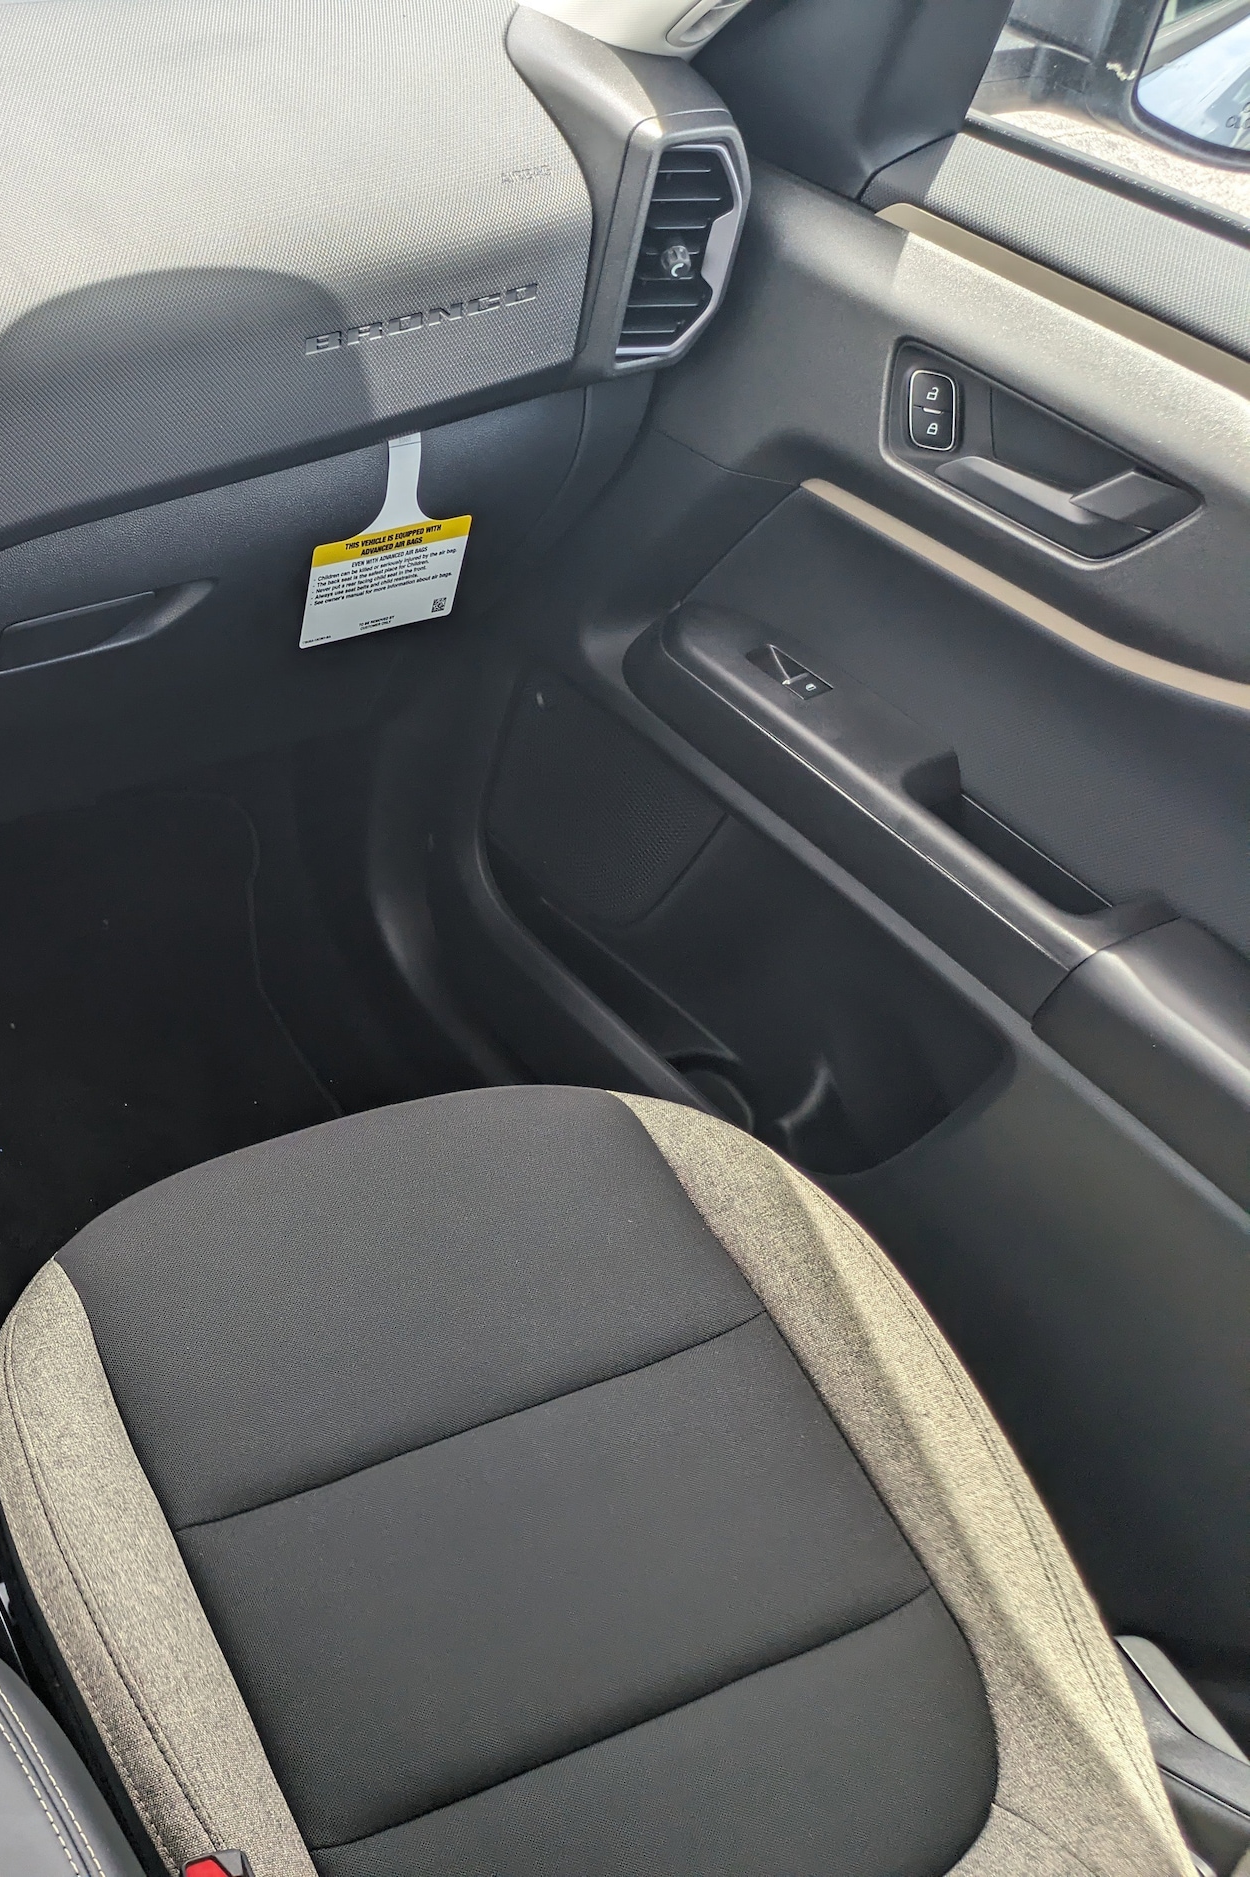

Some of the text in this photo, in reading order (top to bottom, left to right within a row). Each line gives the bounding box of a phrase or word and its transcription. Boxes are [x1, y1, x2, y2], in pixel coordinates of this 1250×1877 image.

[305, 282, 537, 356] BRONCO
[346, 542, 359, 550] THIS
[362, 536, 386, 547] VEHICLE
[395, 528, 424, 539] EQUIPPED
[426, 524, 442, 533] WITH
[361, 544, 394, 556] ADVANCED
[406, 537, 422, 546] BAGS
[380, 552, 404, 562] ADVANCED
[415, 546, 428, 554] BAGS
[380, 560, 402, 568] seriously
[358, 578, 372, 586] facing
[315, 592, 333, 600] Always
